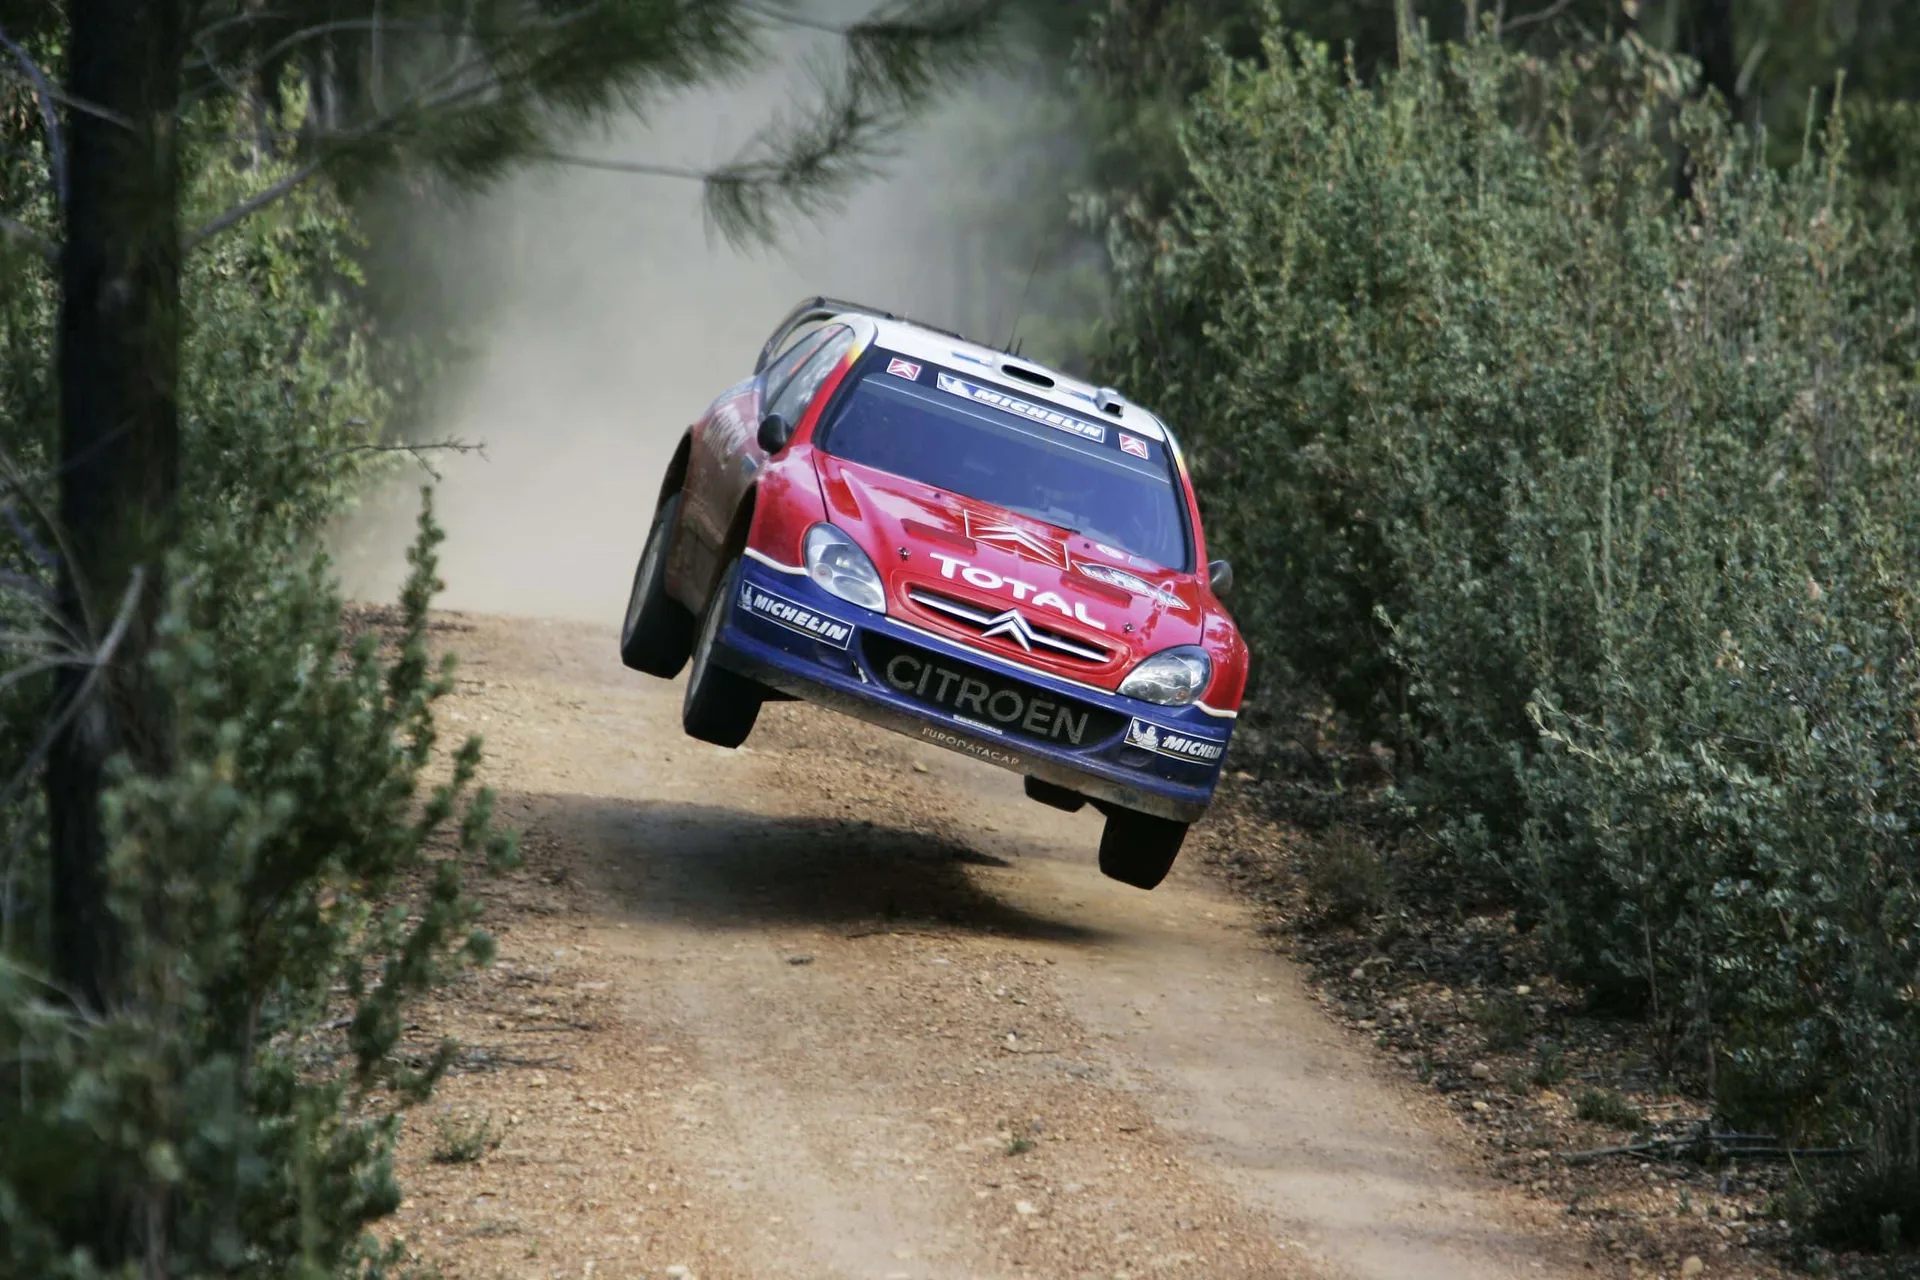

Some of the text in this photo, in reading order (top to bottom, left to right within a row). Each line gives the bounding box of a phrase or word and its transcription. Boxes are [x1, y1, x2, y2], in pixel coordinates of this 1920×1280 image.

[972, 388, 1102, 439] MICHELIN
[930, 552, 1106, 630] TOTAL
[753, 594, 848, 641] MICHELIN
